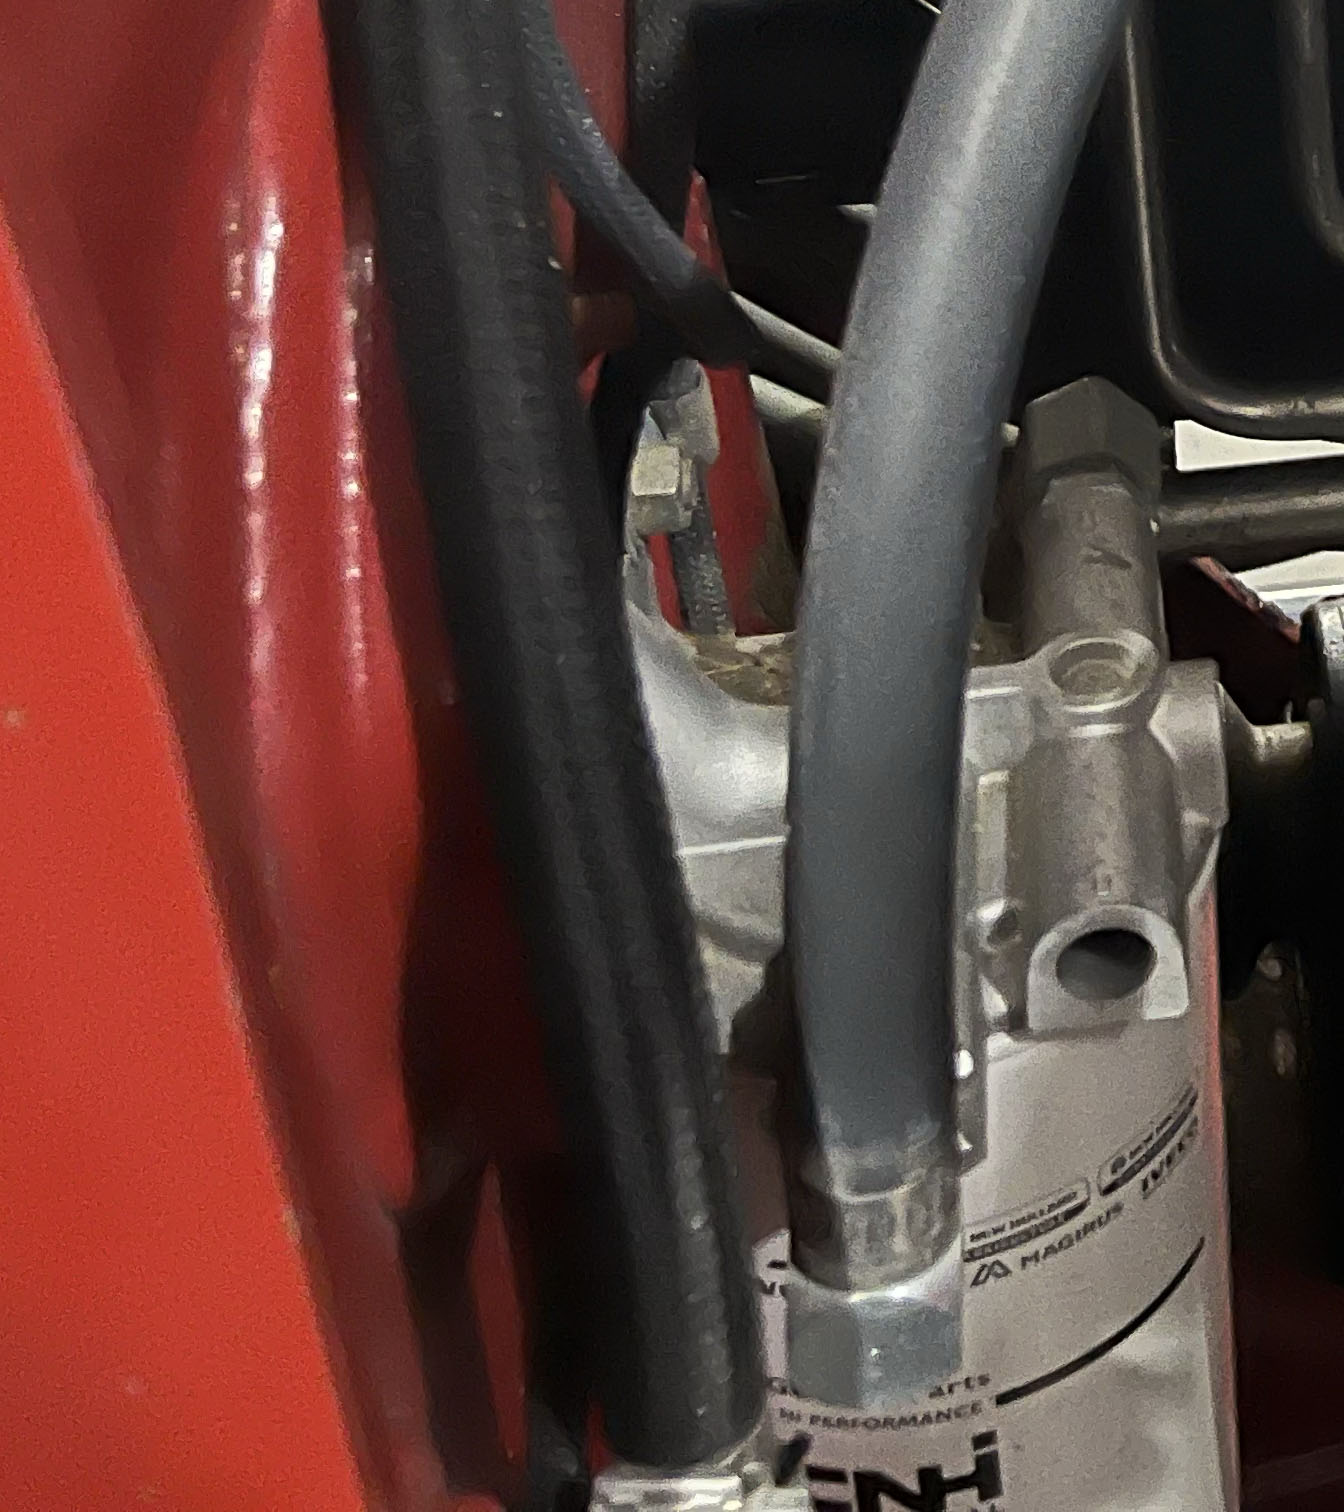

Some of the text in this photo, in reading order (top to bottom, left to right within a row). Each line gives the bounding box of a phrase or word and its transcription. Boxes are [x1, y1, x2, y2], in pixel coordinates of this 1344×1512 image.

[1020, 1201, 1126, 1272] MAGIRUS
[927, 1372, 991, 1399] arts
[808, 1399, 983, 1431] PERFORMANCE
